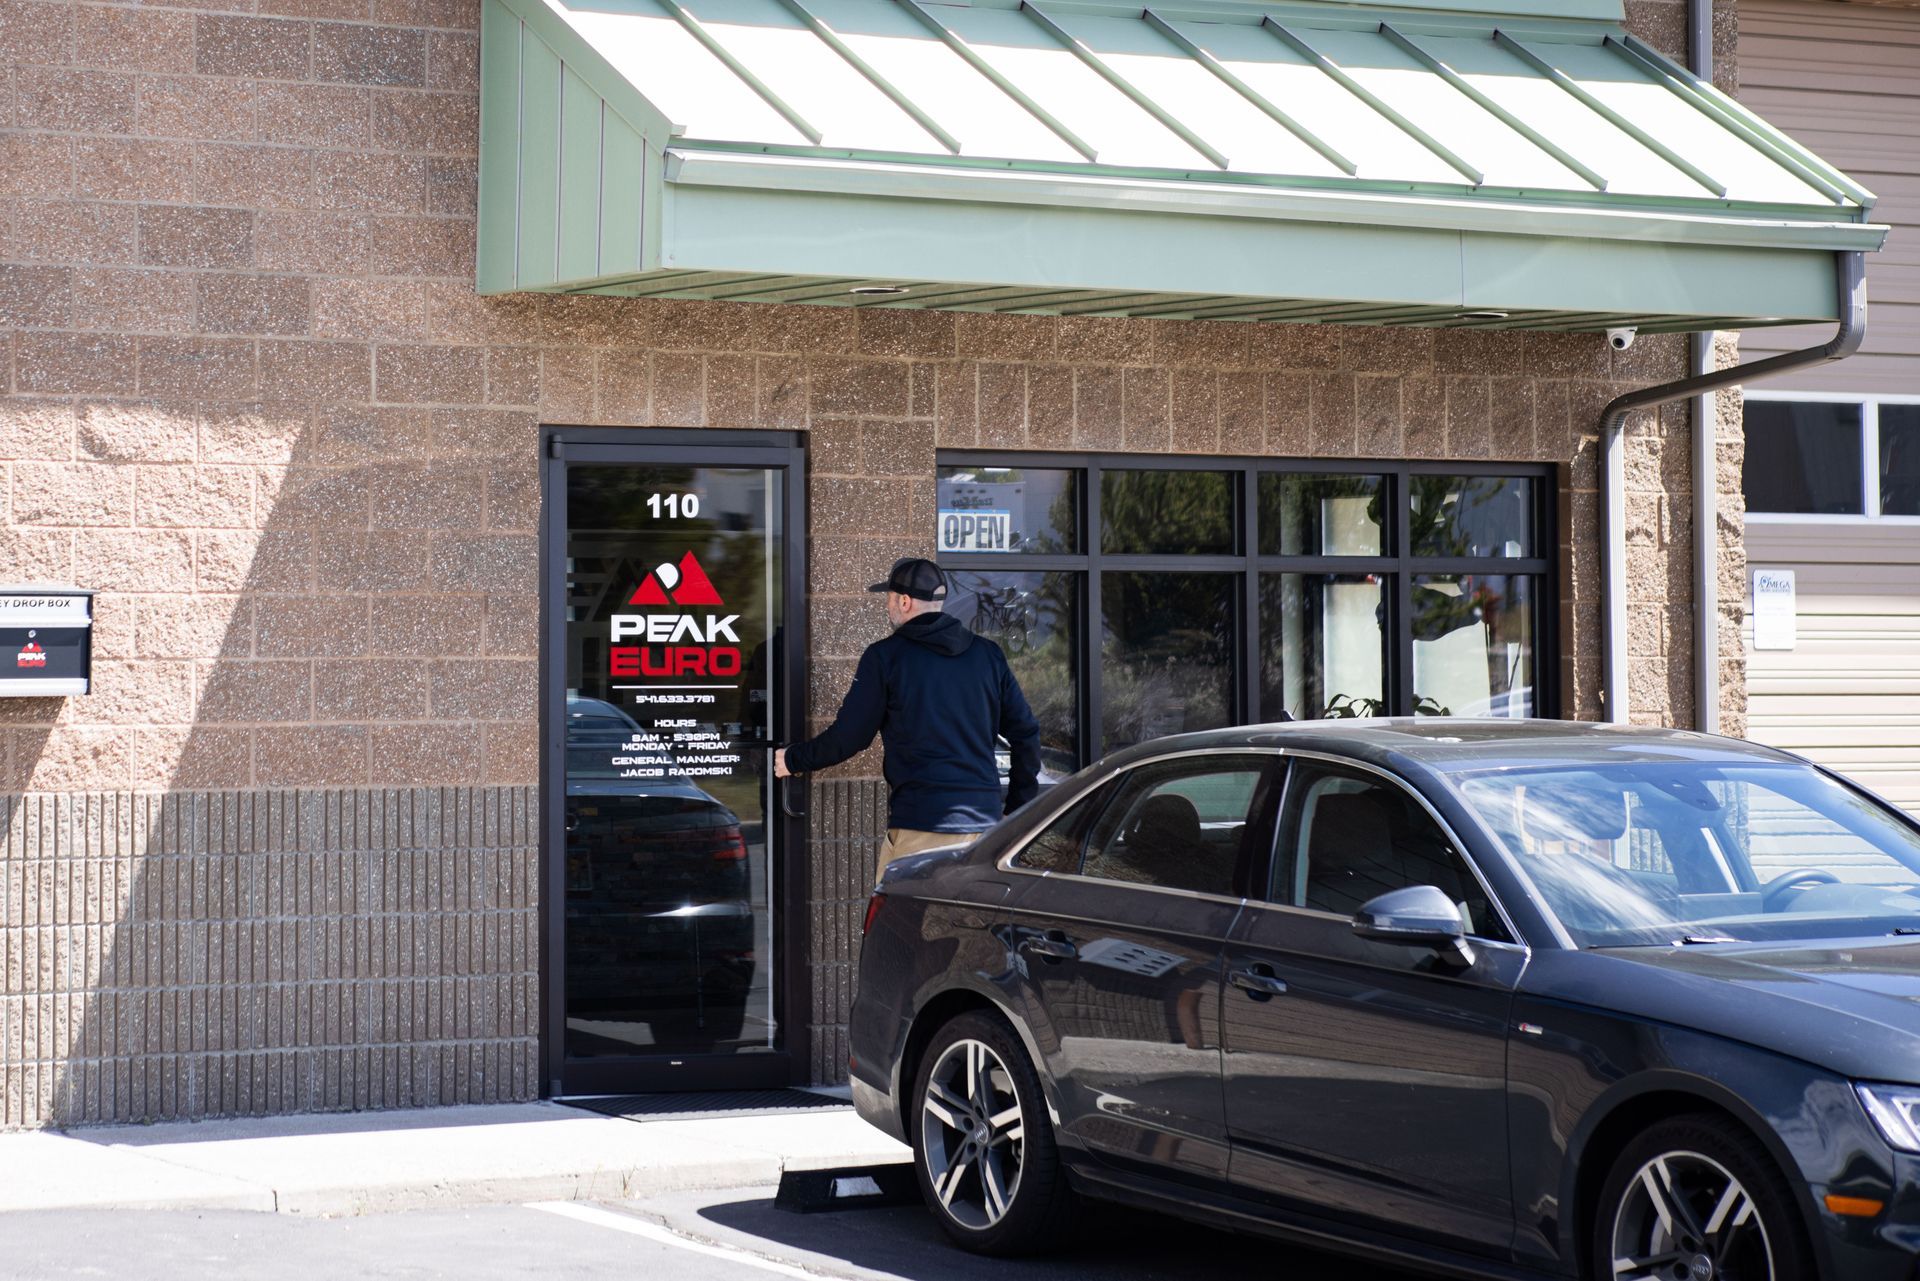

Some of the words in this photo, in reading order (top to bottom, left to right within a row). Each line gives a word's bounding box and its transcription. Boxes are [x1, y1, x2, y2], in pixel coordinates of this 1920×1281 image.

[647, 493, 699, 519] 110
[944, 515, 1005, 549] OPEN
[13, 599, 45, 607] DROP
[47, 599, 71, 607] BOX
[610, 614, 741, 642] PEAK
[610, 646, 741, 676] EURO
[635, 695, 715, 704] 541.633.3781
[654, 719, 697, 728] HOURS
[631, 734, 659, 742] 8AM
[673, 733, 720, 742] 5:30PM
[622, 742, 674, 751] MONDAY
[687, 741, 731, 750] FRIDAY
[611, 756, 673, 766] GENERAL
[676, 755, 741, 764] MANAGER:
[620, 768, 665, 778] JACOB
[668, 766, 733, 777] RADOMSKI
